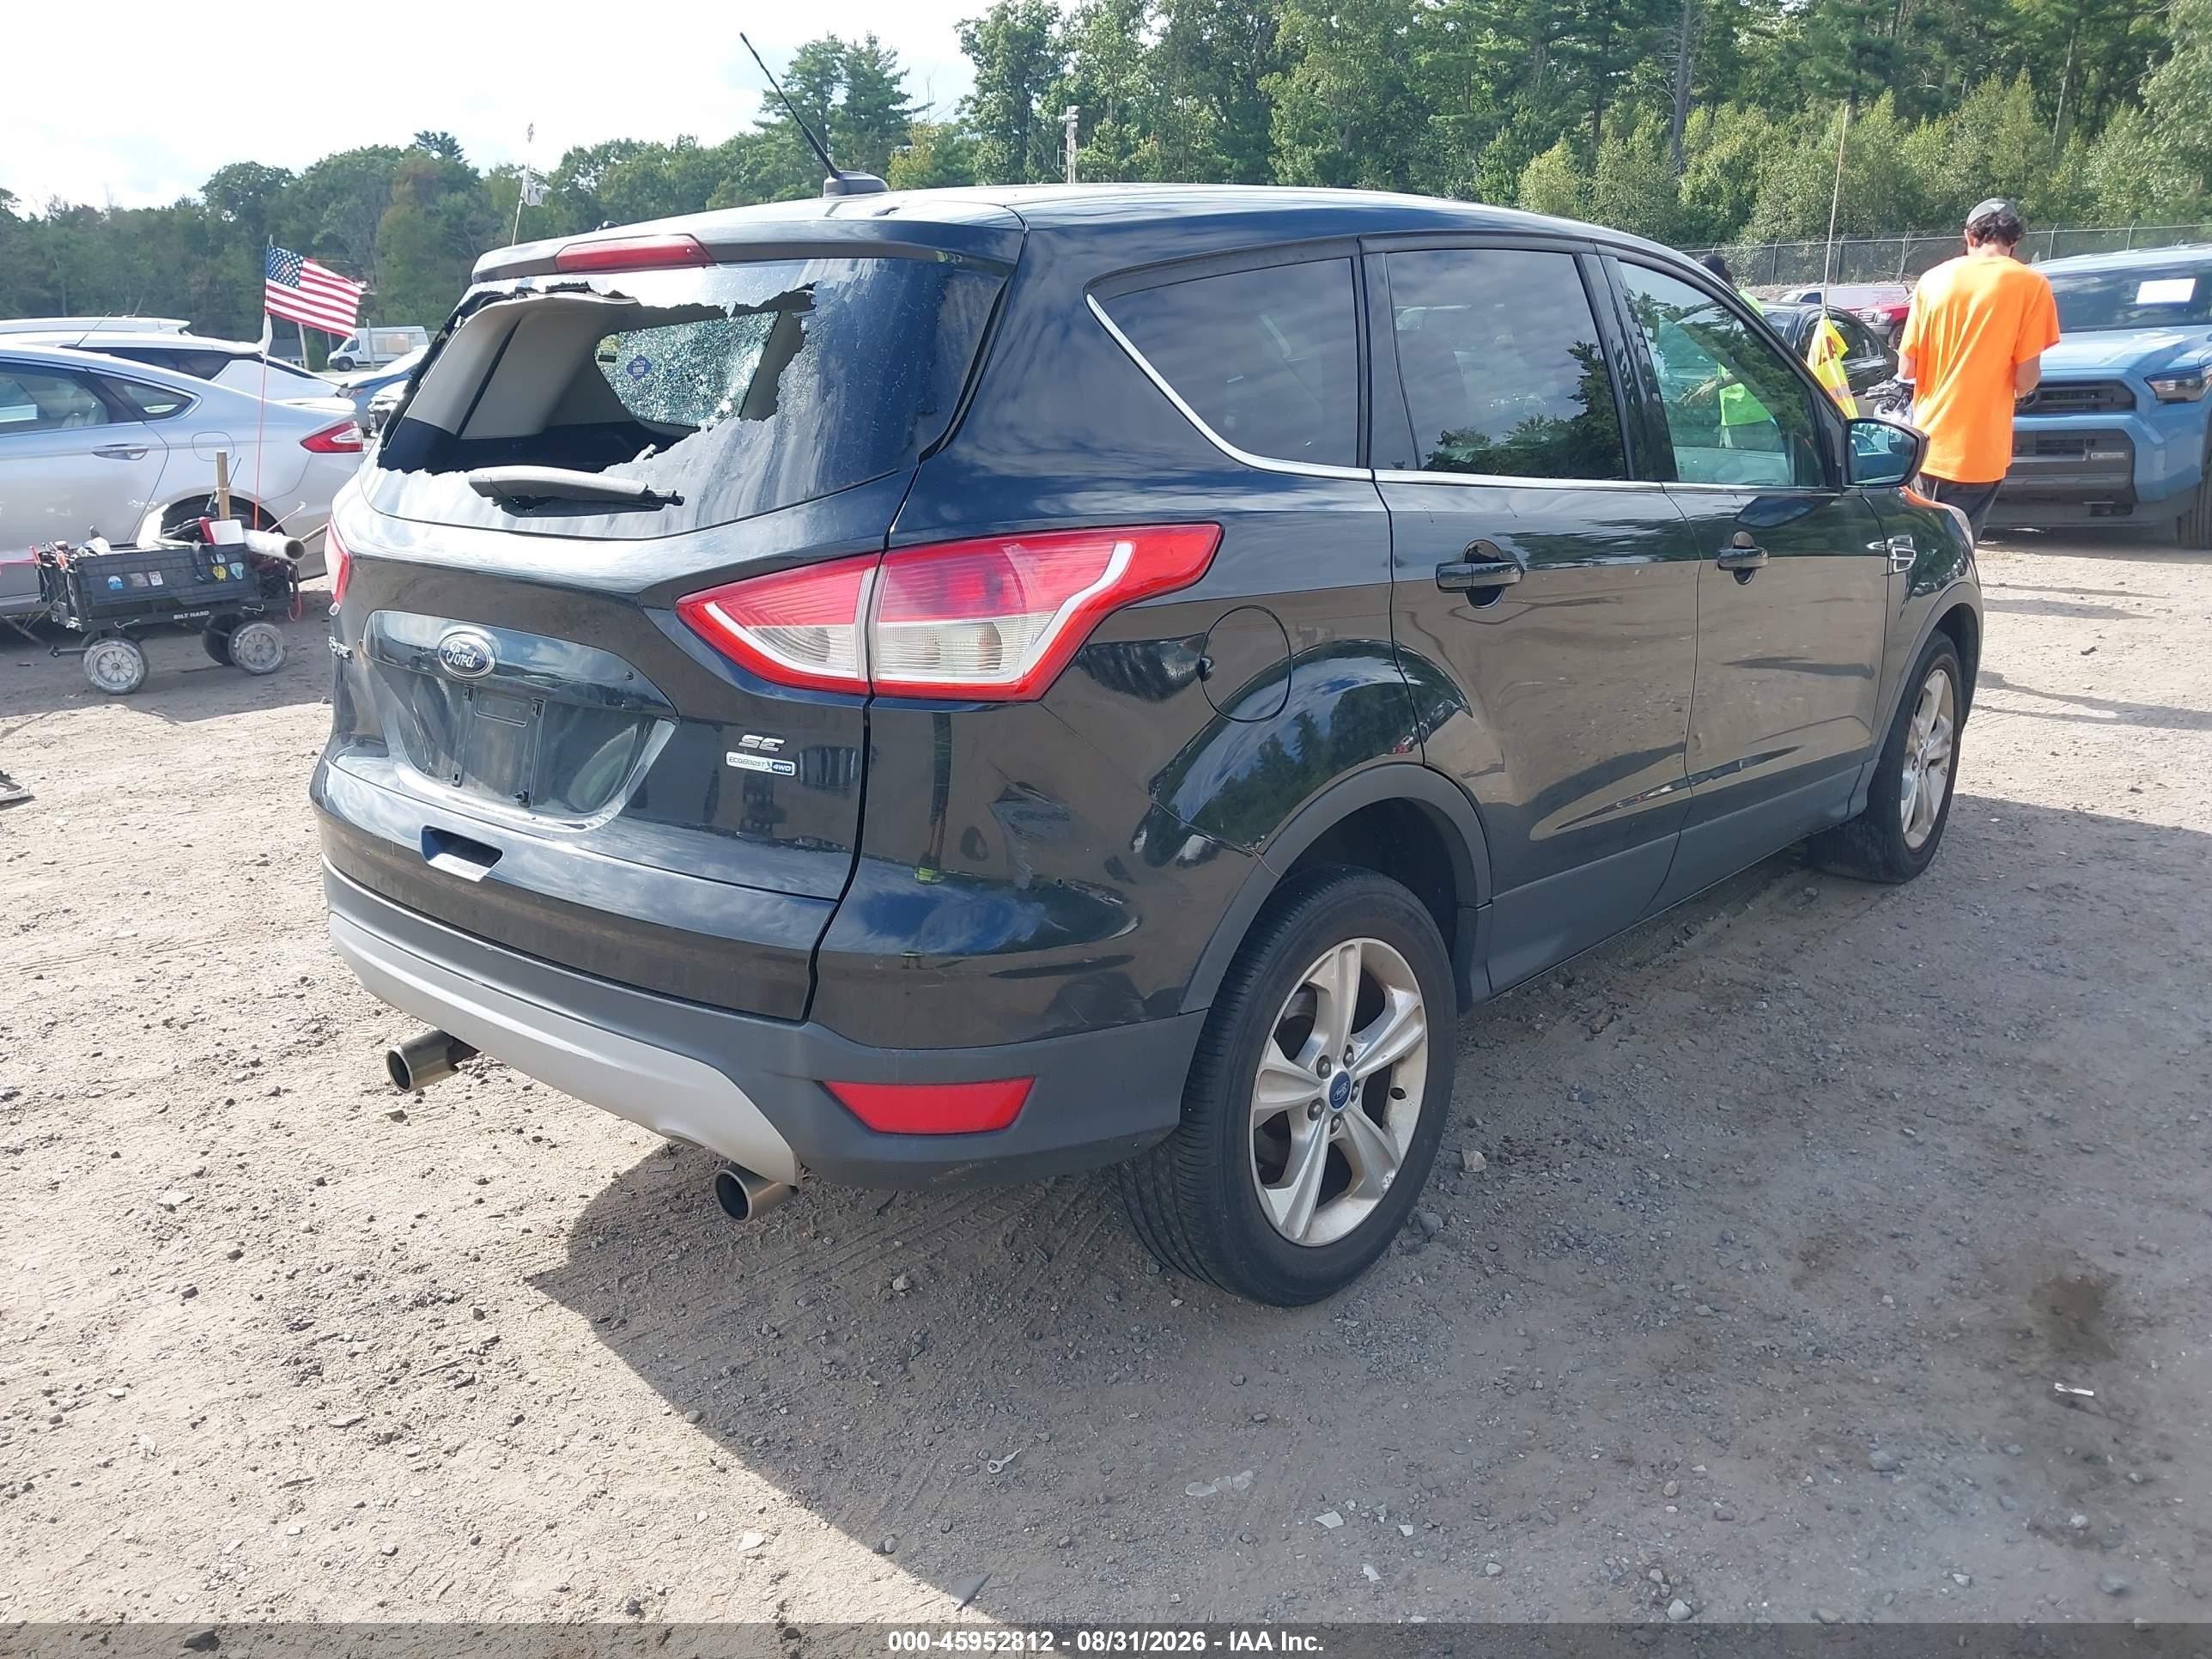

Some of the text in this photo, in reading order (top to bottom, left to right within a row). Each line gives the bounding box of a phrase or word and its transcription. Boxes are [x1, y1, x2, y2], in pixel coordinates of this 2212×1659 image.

[447, 641, 477, 668] Ford
[738, 734, 785, 751] SE
[729, 757, 792, 772] ECOBOOST 4WD
